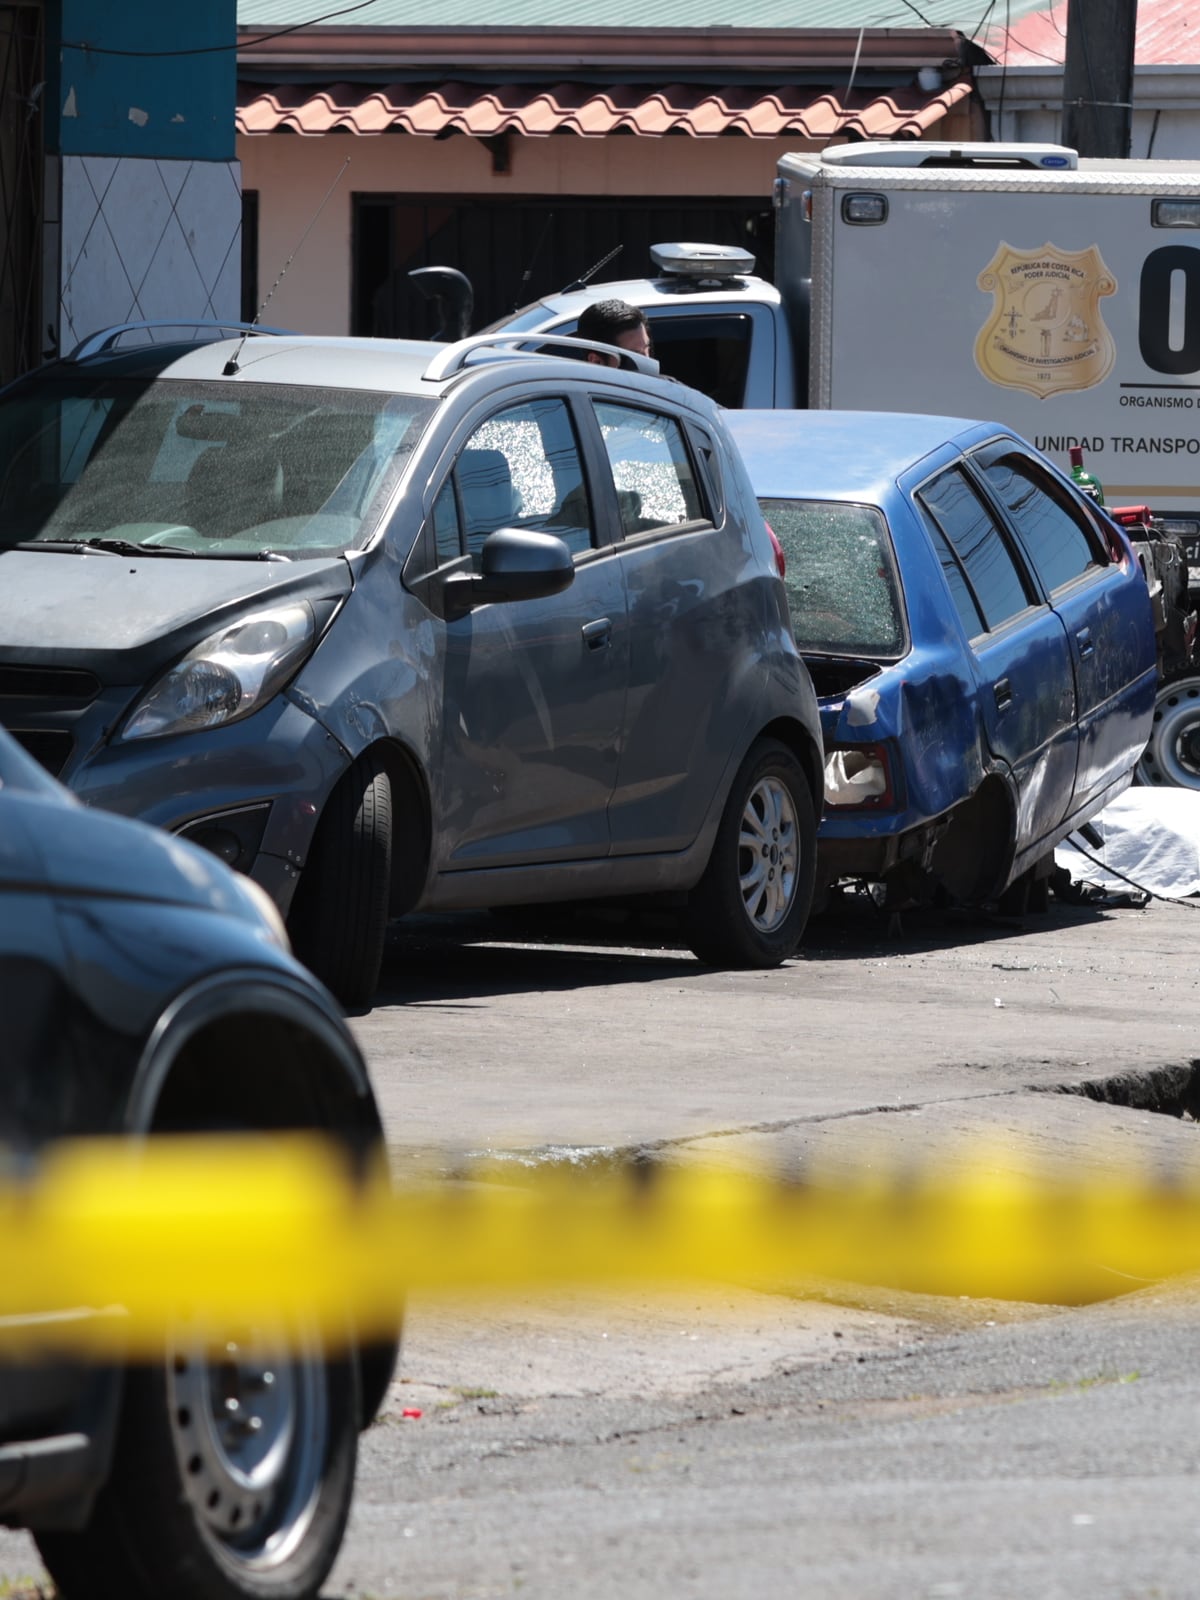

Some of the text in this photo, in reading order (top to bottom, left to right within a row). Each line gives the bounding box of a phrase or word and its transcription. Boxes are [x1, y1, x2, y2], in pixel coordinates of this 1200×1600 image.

[1011, 261, 1084, 278] REPÚBLICA DE COSTA RICA
[1024, 271, 1070, 280] PODER JUDICIAL
[999, 344, 1027, 361] ORGANISMO
[1074, 349, 1094, 360] JUDICIAL
[1119, 395, 1194, 408] ORGANISMO
[1034, 436, 1105, 453] UNIDAD
